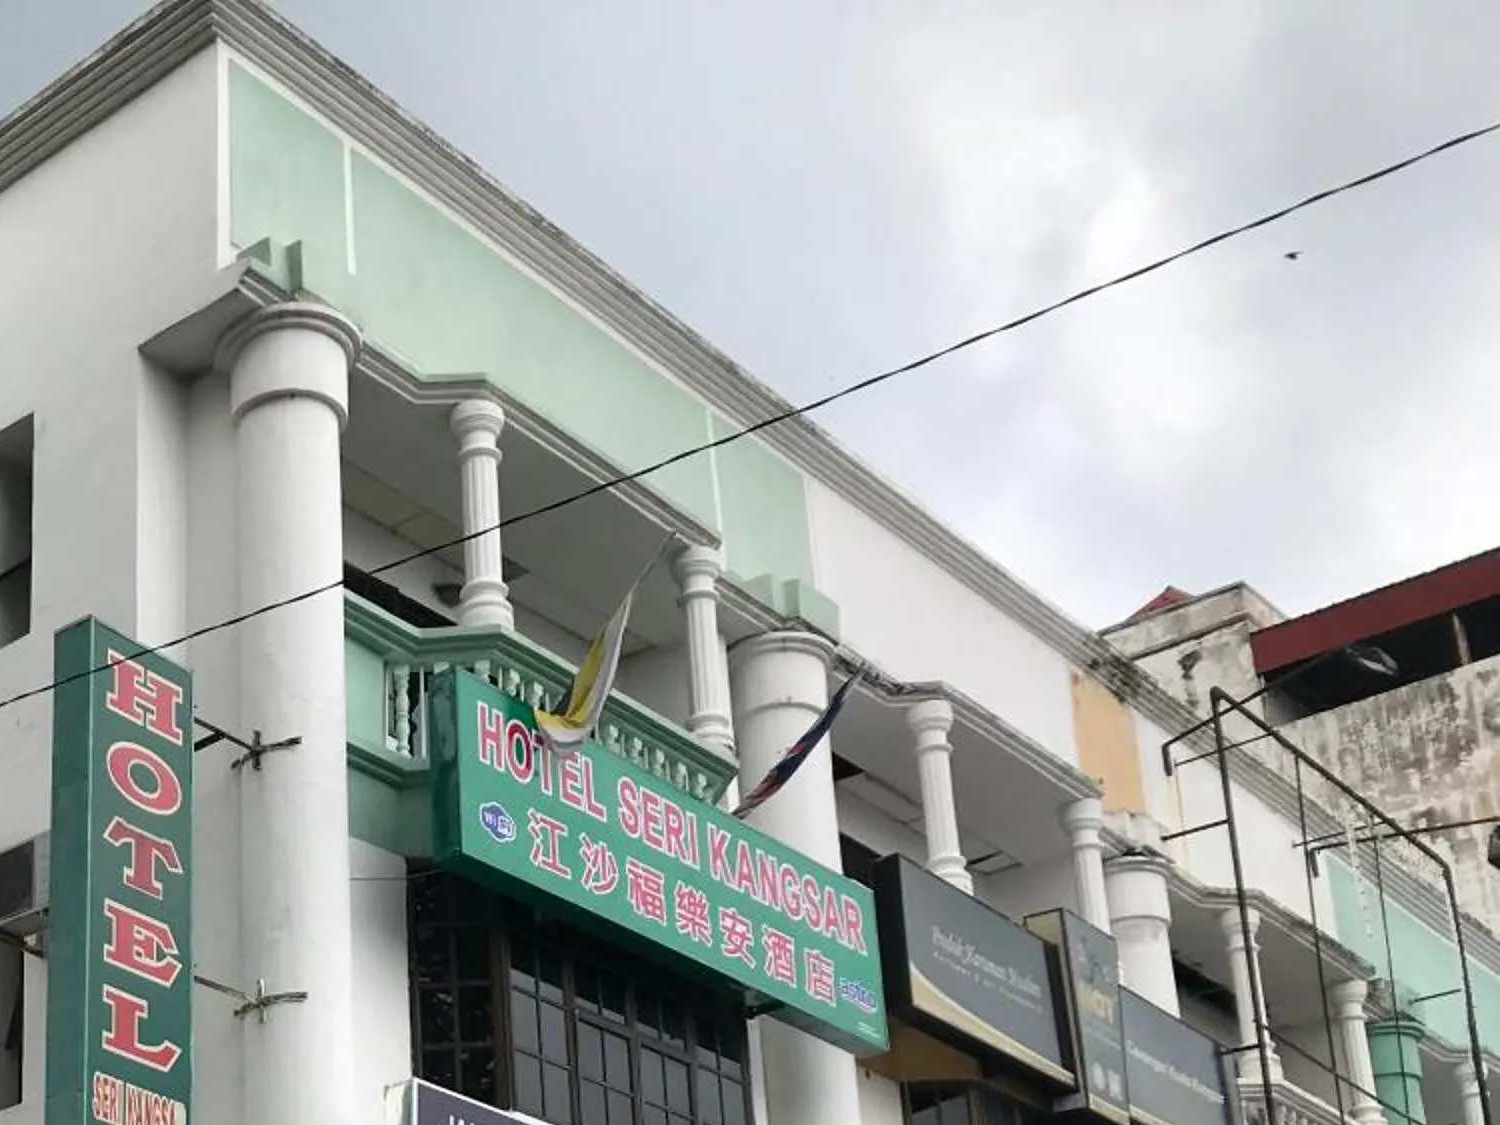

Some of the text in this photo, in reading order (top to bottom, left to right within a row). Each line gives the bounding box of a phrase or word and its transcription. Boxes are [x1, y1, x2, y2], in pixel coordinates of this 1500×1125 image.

[102, 648, 184, 1072] HOTEL
[477, 701, 868, 956] HOTEL SERI KANGSAR
[527, 807, 837, 1007] 江沙福樂安酒店
